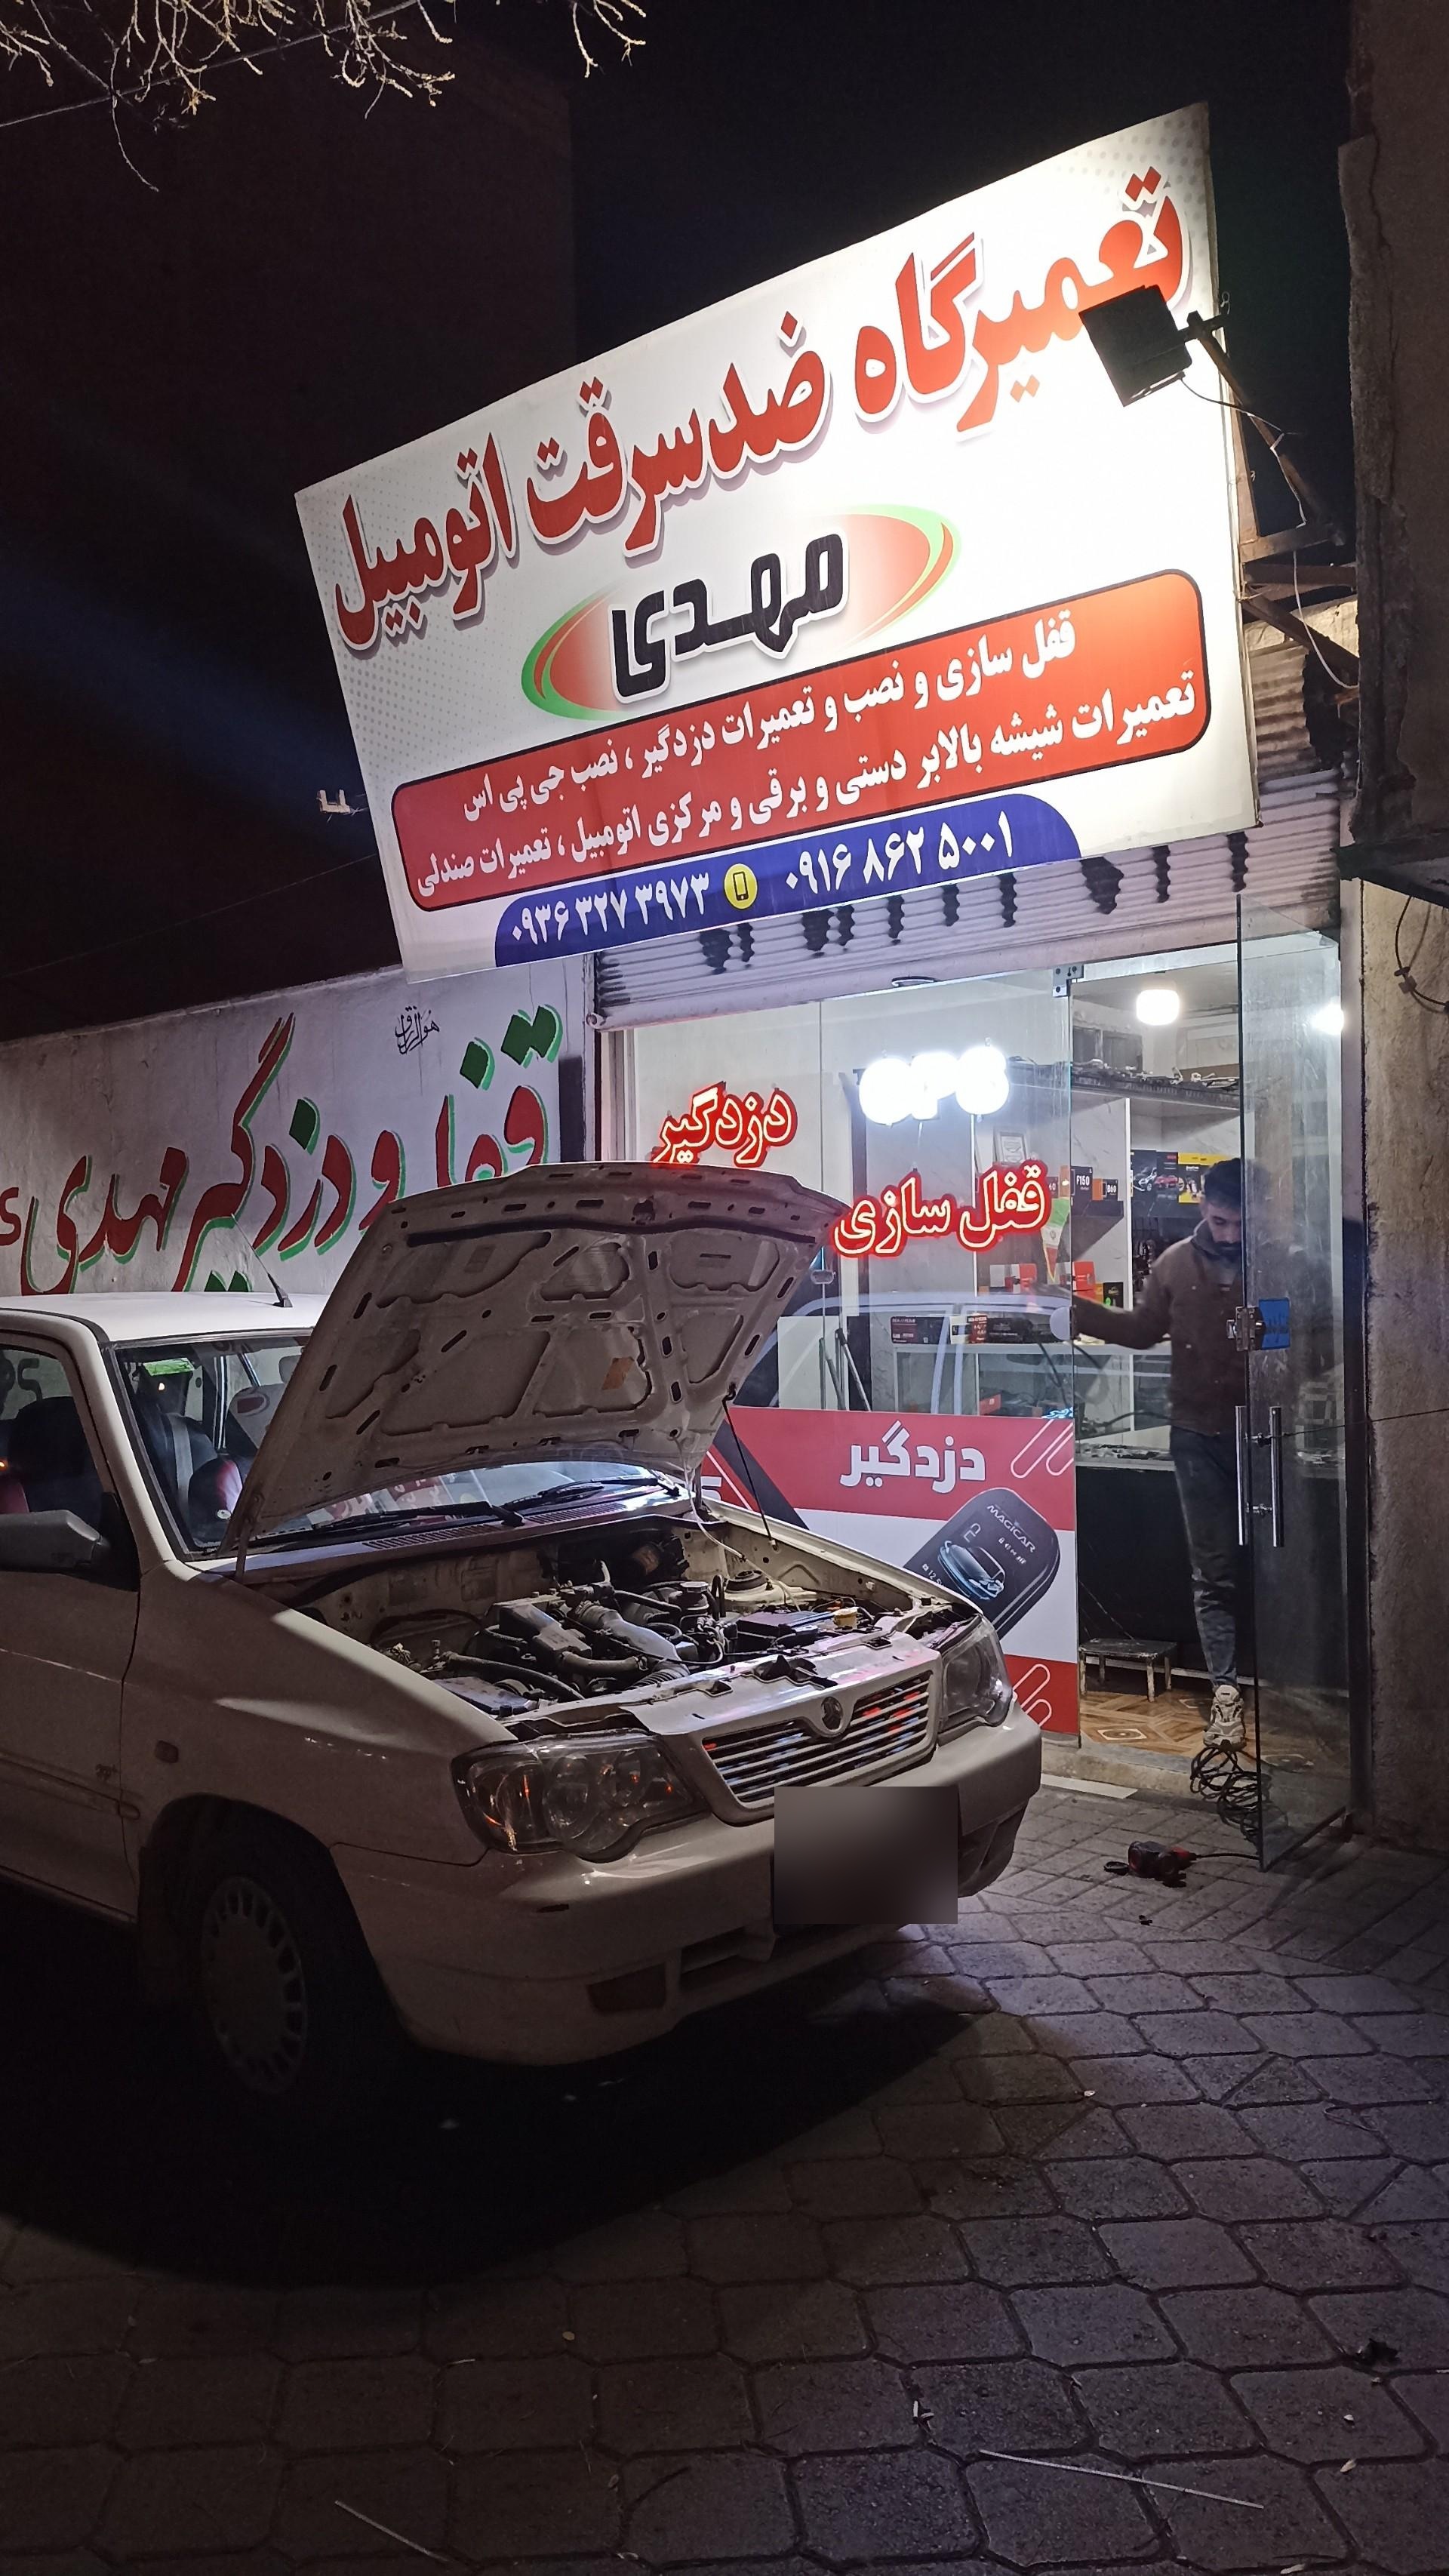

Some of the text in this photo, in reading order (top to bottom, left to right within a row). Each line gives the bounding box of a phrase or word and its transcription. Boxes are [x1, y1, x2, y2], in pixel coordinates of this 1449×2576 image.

[854, 165, 1184, 433] تعمیرگاه
[334, 432, 514, 645] اتومبیل
[611, 534, 843, 698] مهدی
[1023, 610, 1075, 679] قفل
[844, 660, 905, 724] نصب
[914, 670, 928, 709] و
[937, 635, 1014, 699] سازی
[722, 685, 815, 749] تعمیرات
[825, 695, 838, 732] و
[990, 703, 1063, 760] شیشه
[1072, 670, 1196, 745] تعمیرات
[571, 740, 619, 791] نصب
[642, 722, 715, 779] دزدگیر
[835, 749, 906, 805] دستی
[917, 723, 983, 789] بالابر
[463, 774, 494, 822] اس
[499, 775, 527, 812] پی
[531, 763, 565, 805] جی
[749, 768, 807, 824] برقی
[816, 777, 829, 811] و
[571, 805, 641, 862] اتومبیل
[648, 792, 722, 847] مرکزی
[731, 796, 743, 830] و
[417, 853, 475, 897] صندلی
[480, 828, 552, 879] تعمیرات
[785, 811, 1014, 894] ۰۹۱۶ ۸۶۲ ۵۰۰۱
[512, 872, 710, 945] ۰۹۳۶ ۳۲۷ ۳۹۷۳
[654, 1085, 795, 1165] دزدگیر
[834, 1163, 1048, 1255] قفل سازی
[840, 1420, 986, 1494] دزدگیر
[986, 1505, 1036, 1553] MAGICAR
